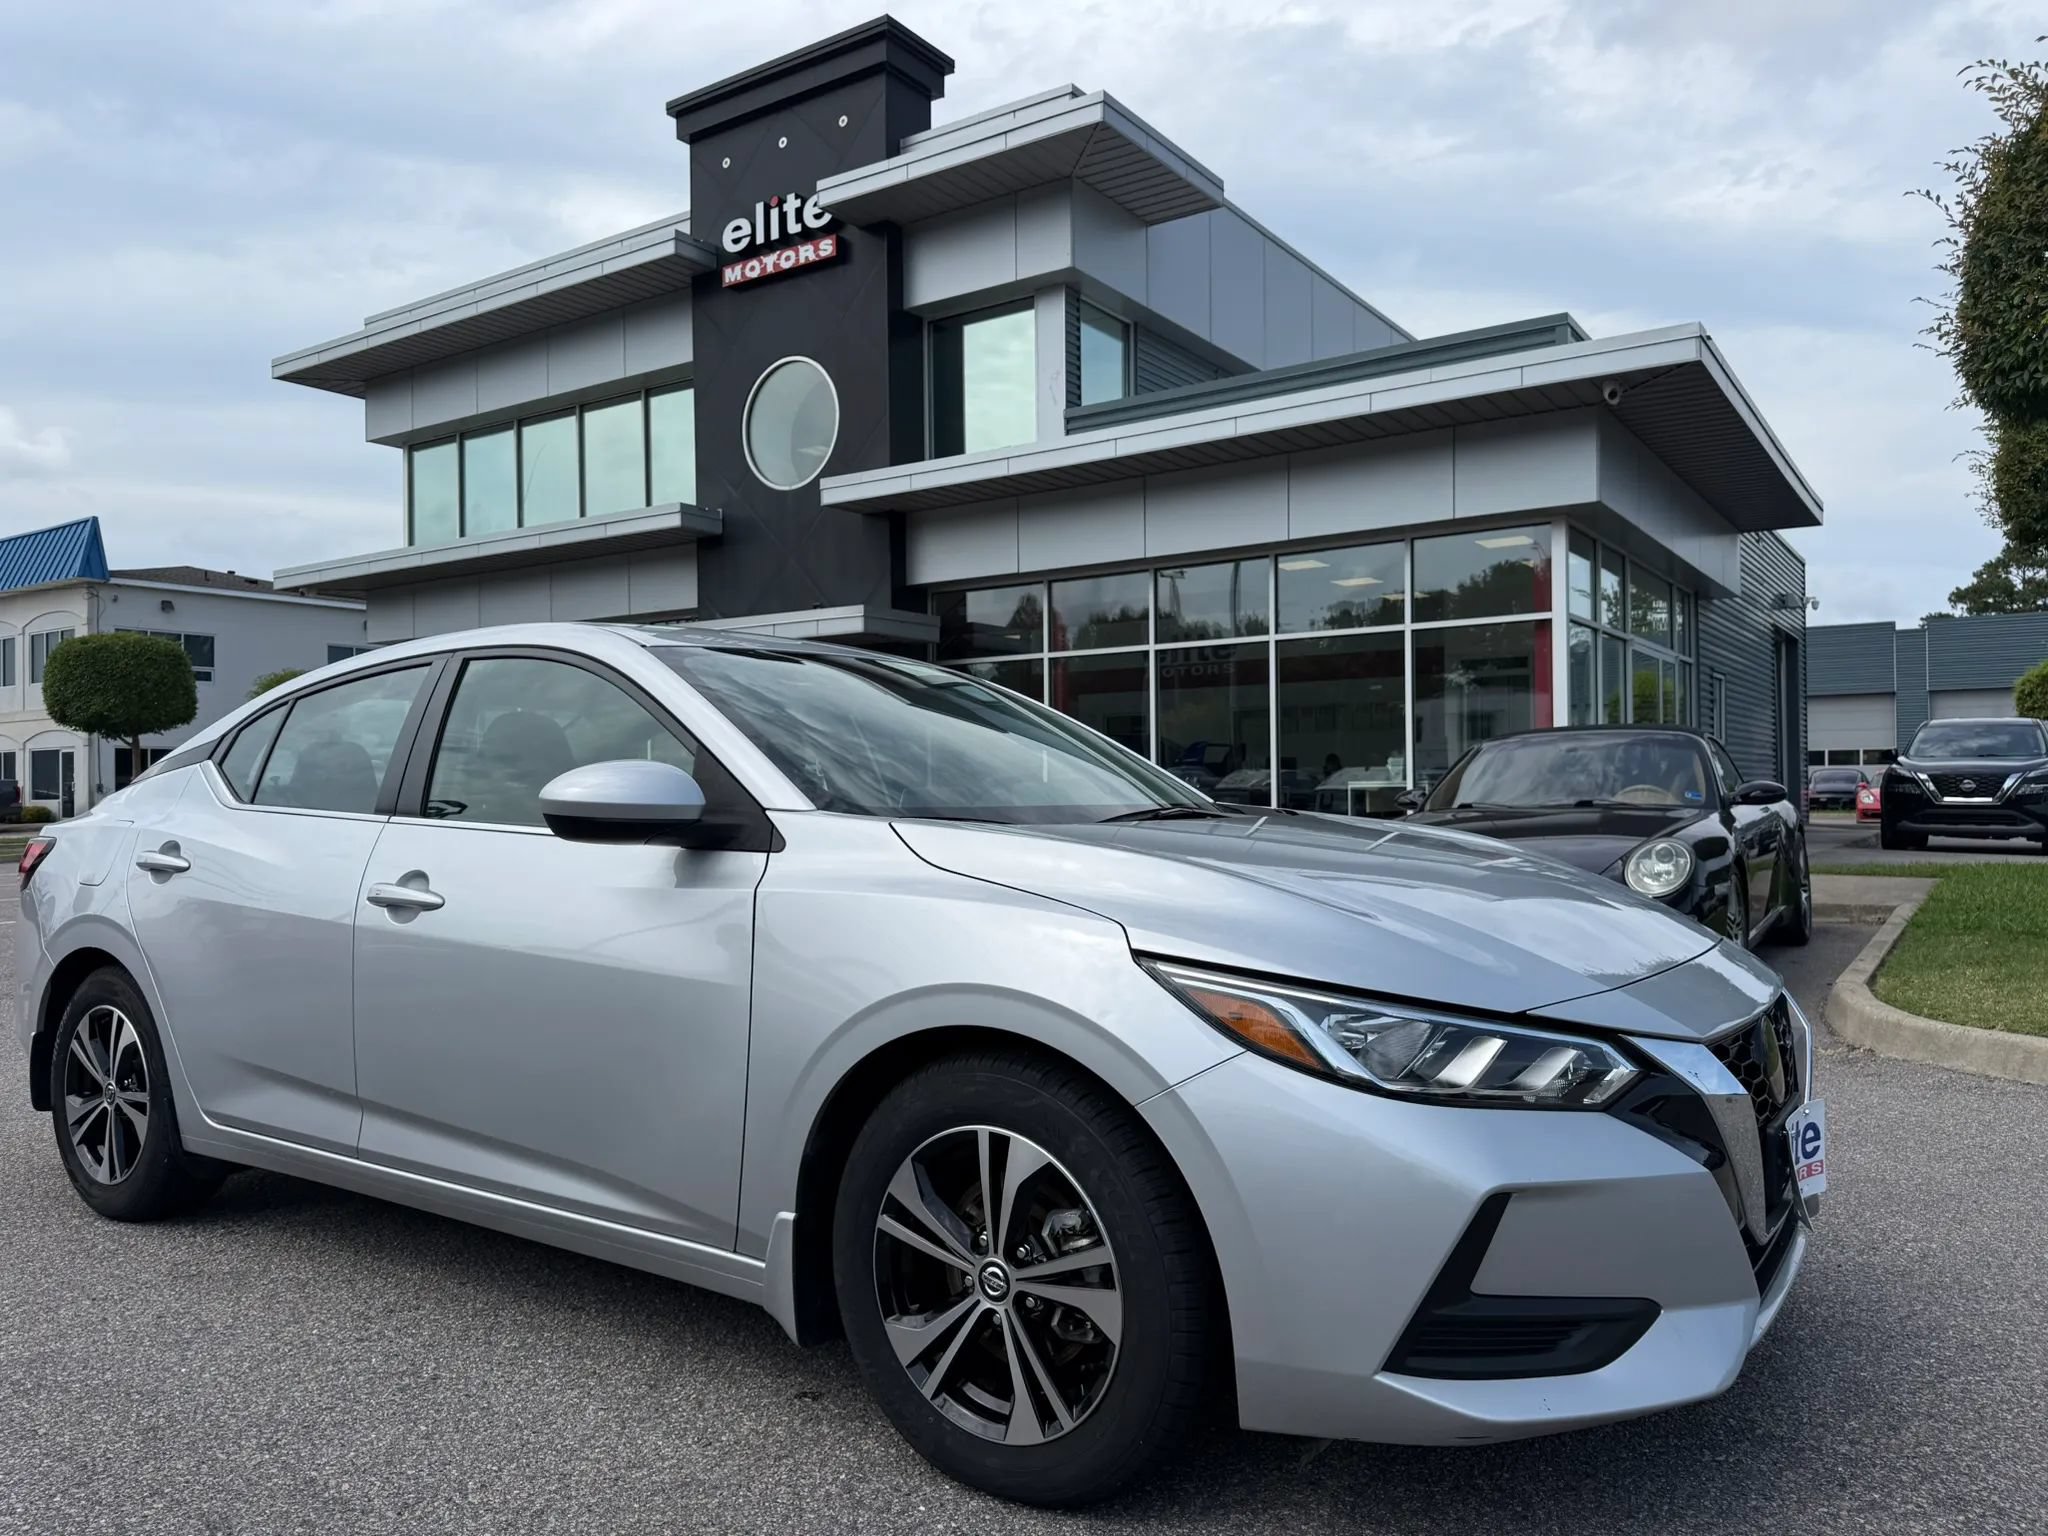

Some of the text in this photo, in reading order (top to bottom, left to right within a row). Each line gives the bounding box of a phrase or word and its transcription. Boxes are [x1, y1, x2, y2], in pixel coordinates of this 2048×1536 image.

[722, 192, 833, 253] elite
[724, 239, 834, 283] MOTORS
[1799, 1162, 1822, 1180] RS
